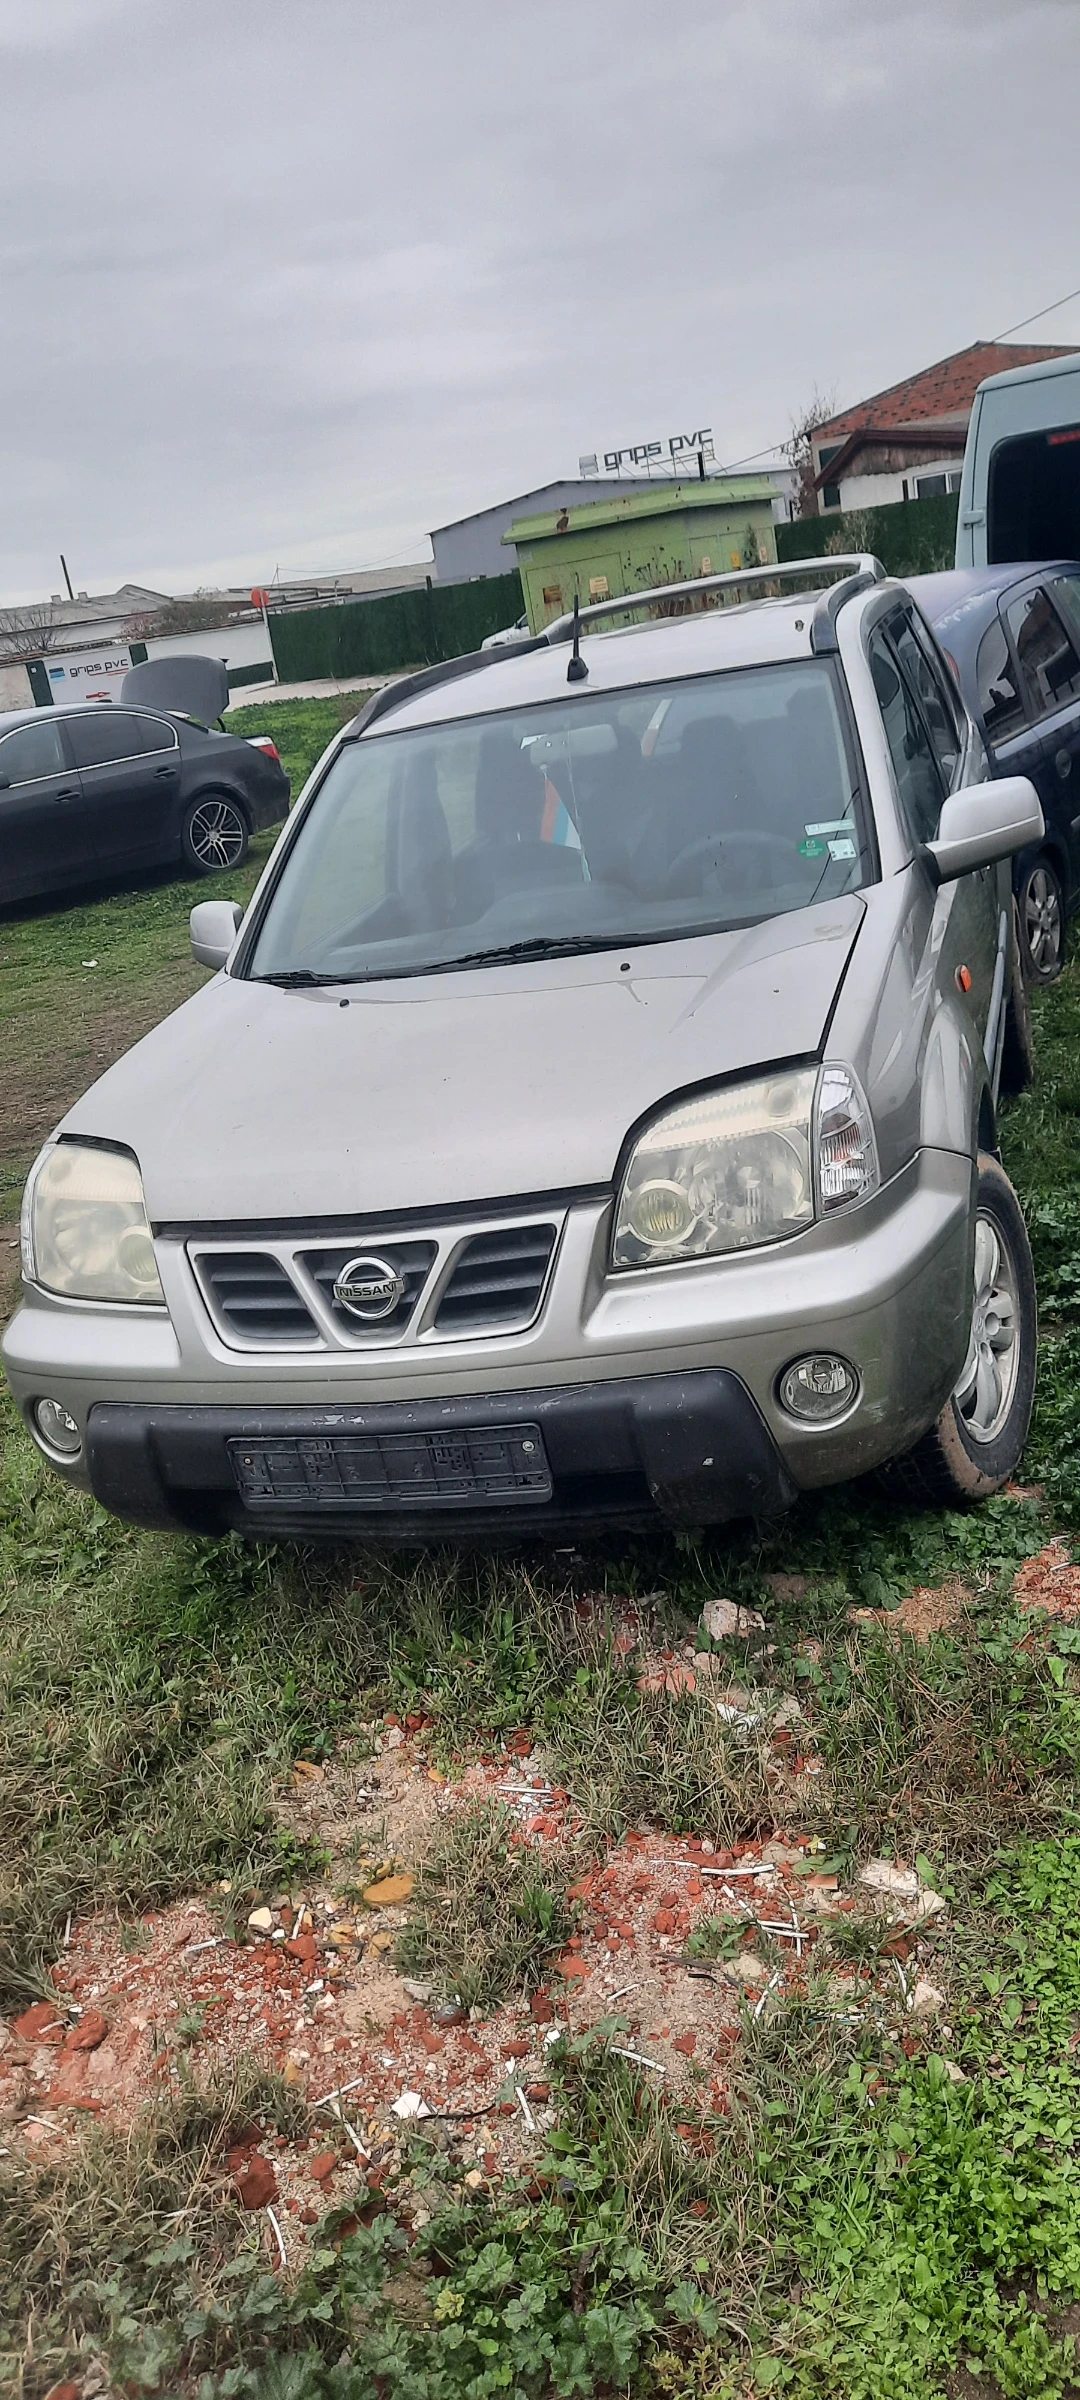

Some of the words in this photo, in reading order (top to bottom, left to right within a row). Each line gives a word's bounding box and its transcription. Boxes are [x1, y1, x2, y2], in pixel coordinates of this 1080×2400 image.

[669, 428, 713, 456] pvc
[105, 658, 129, 672] pvc
[340, 1282, 395, 1297] NISSAN
